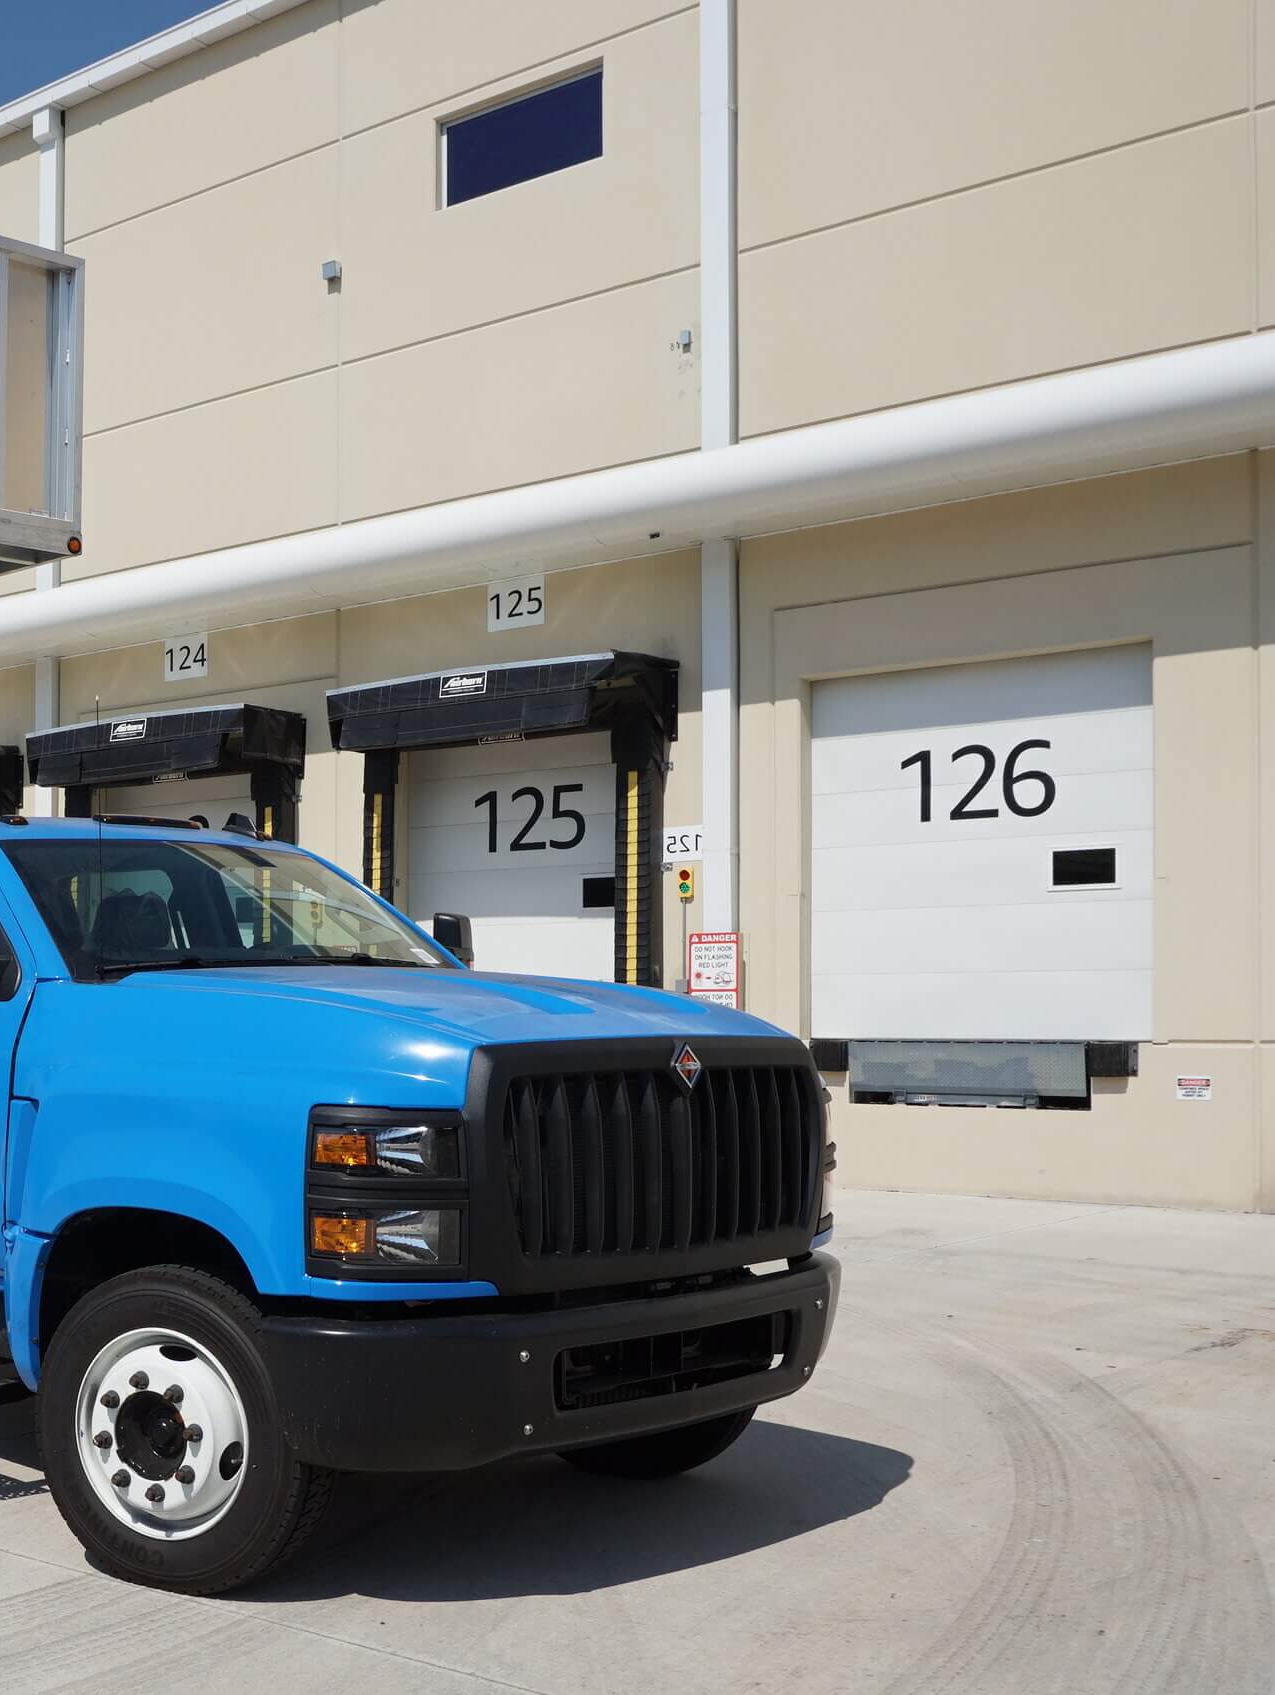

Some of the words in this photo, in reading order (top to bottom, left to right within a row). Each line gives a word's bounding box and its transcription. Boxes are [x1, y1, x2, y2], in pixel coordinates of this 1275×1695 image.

[489, 586, 543, 620] 125
[165, 642, 207, 673] 124
[900, 738, 1056, 823] 126
[474, 783, 586, 853] 125
[701, 934, 737, 942] DANGER
[704, 953, 733, 961] FLASHING
[712, 961, 729, 969] LIGHT
